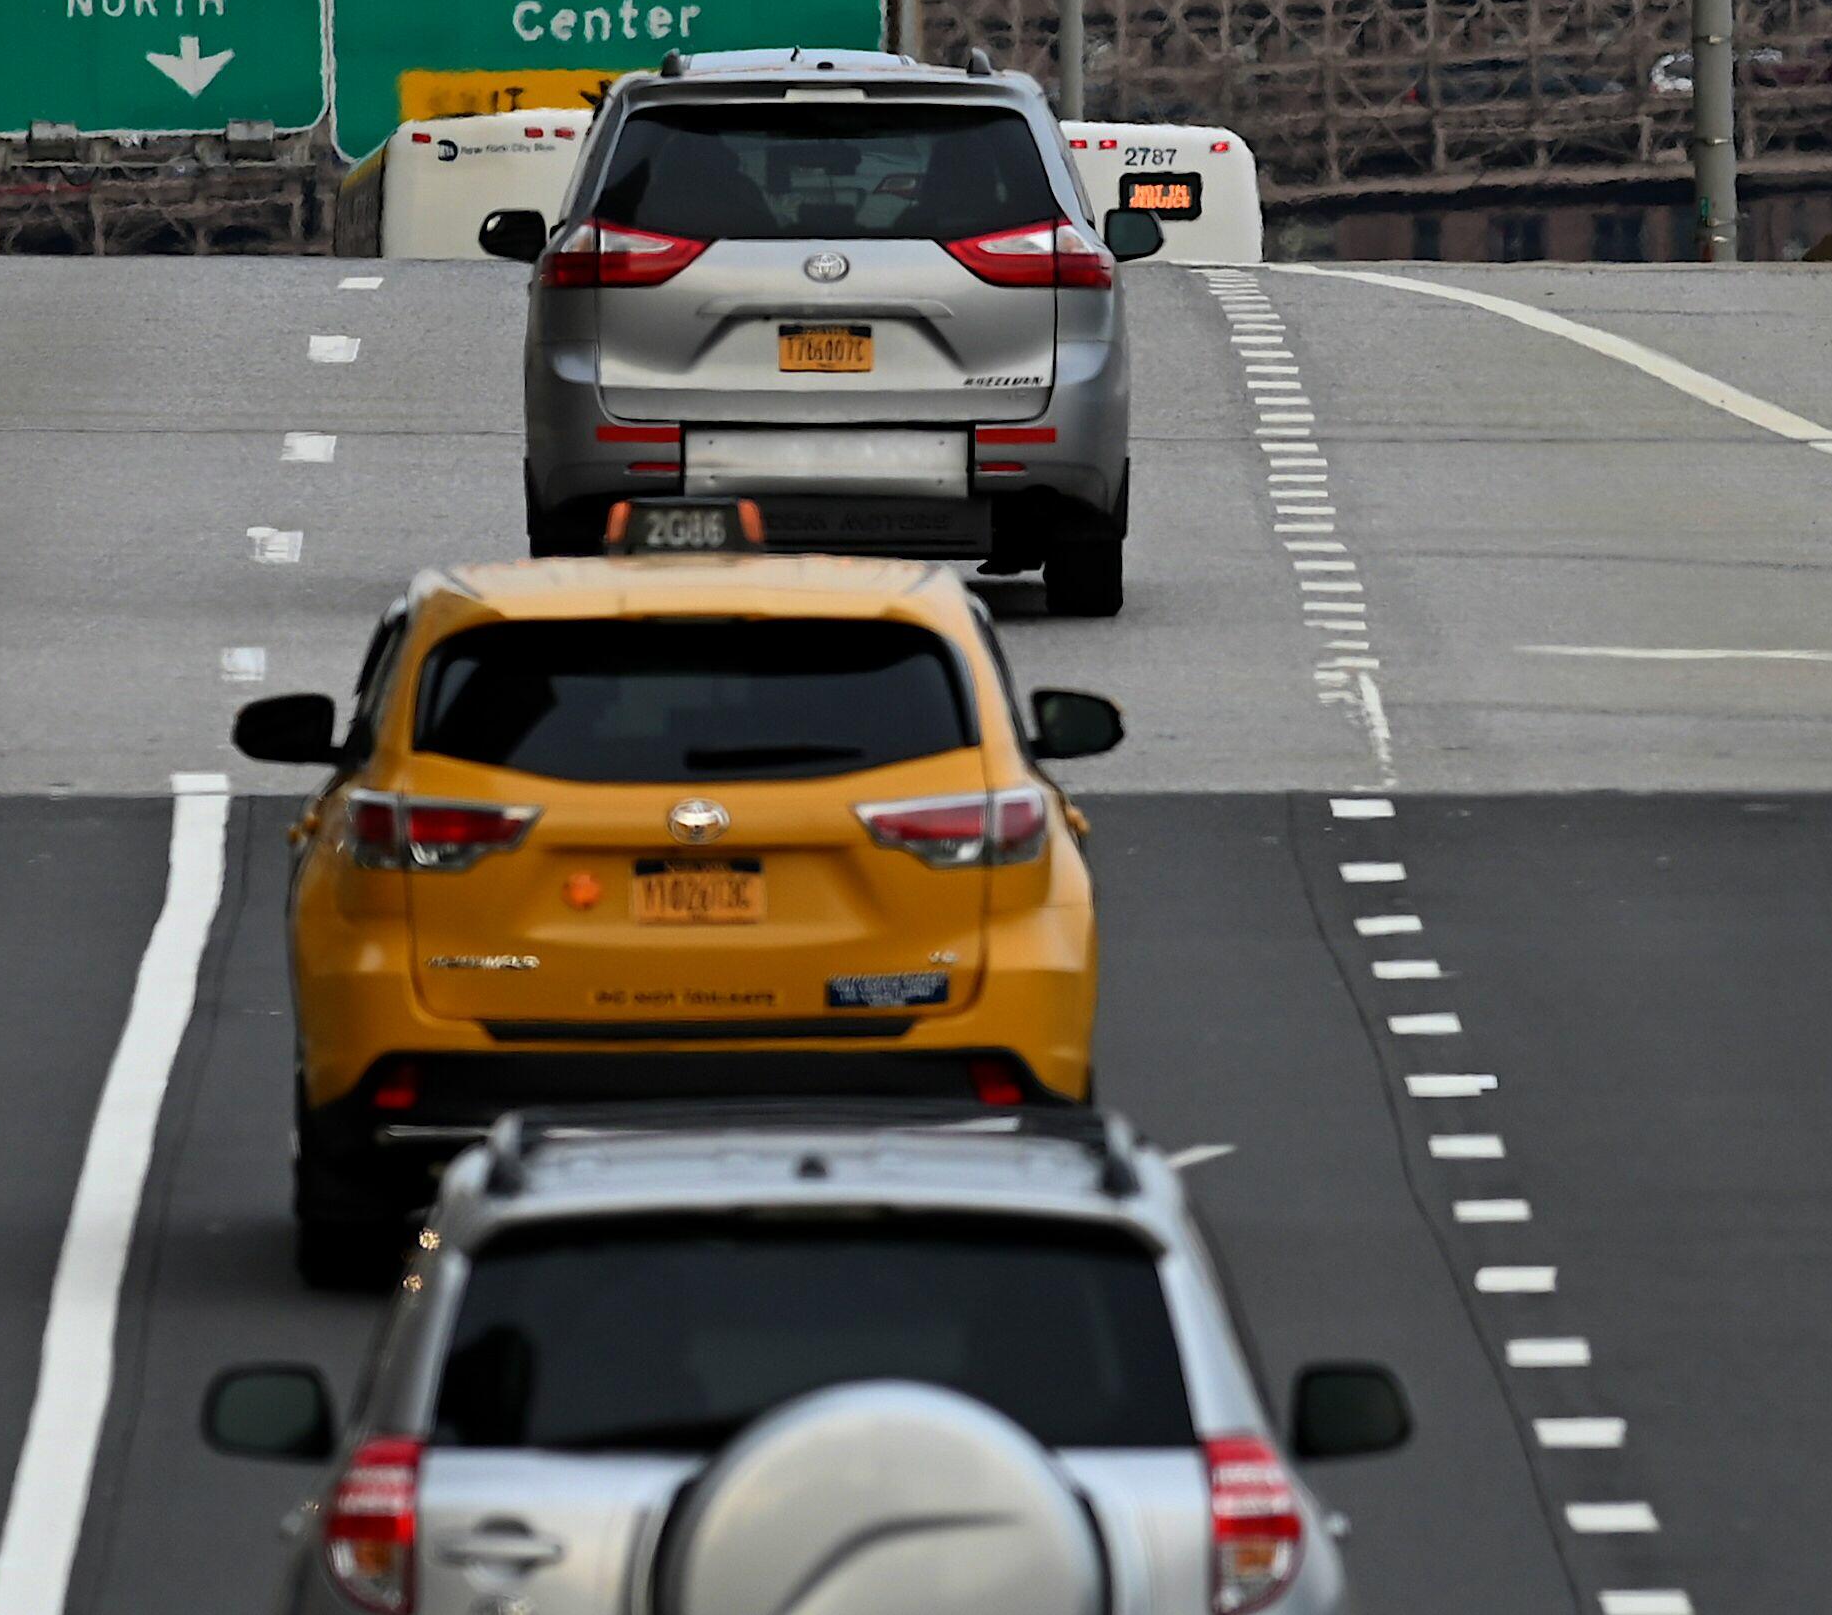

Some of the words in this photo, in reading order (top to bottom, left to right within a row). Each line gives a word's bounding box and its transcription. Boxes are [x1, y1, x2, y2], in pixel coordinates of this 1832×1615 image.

[429, 87, 523, 116] IT
[1124, 147, 1177, 166] 2787
[645, 510, 728, 549] 2G86
